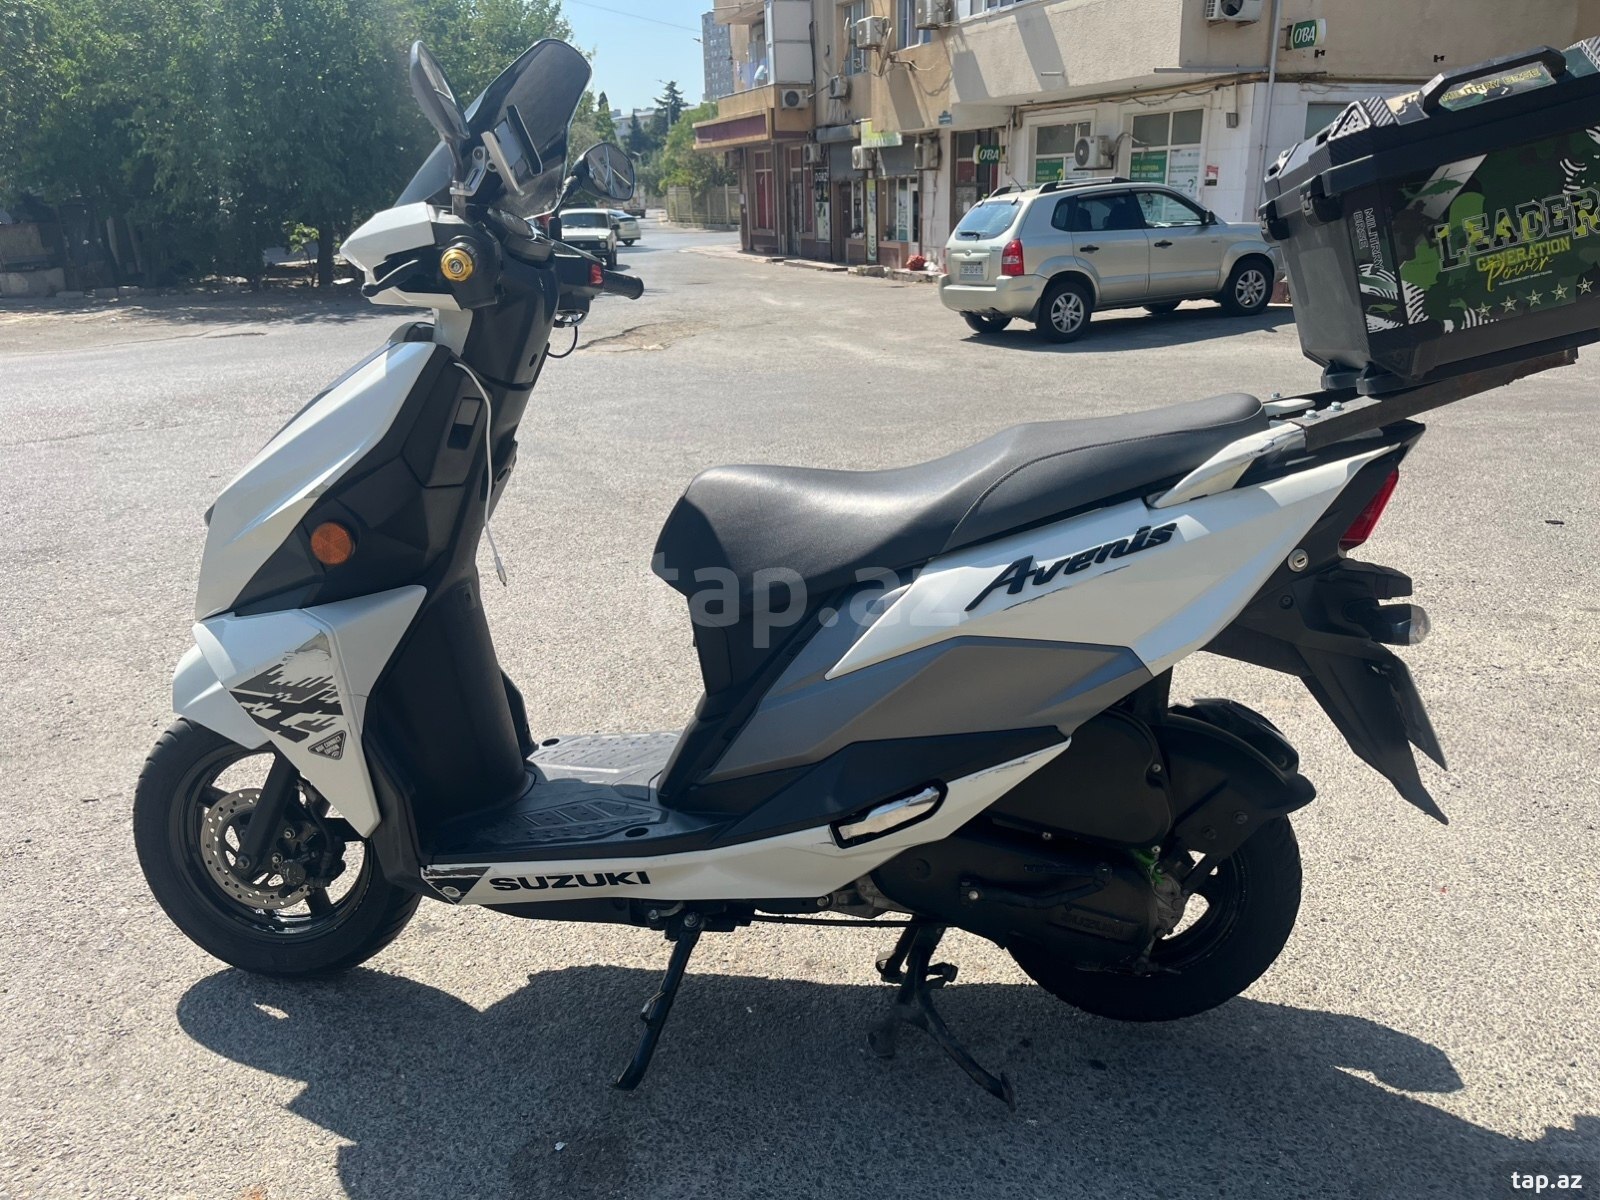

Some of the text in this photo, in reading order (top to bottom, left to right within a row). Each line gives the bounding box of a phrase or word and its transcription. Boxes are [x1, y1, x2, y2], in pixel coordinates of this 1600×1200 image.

[1294, 26, 1316, 44] OBA
[980, 148, 999, 161] OBA
[1434, 187, 1600, 272] LEADER
[1476, 236, 1571, 272] GENERATION
[1484, 256, 1554, 292] Power
[964, 522, 1178, 612] Avenis
[489, 871, 651, 891] SUZUKI
